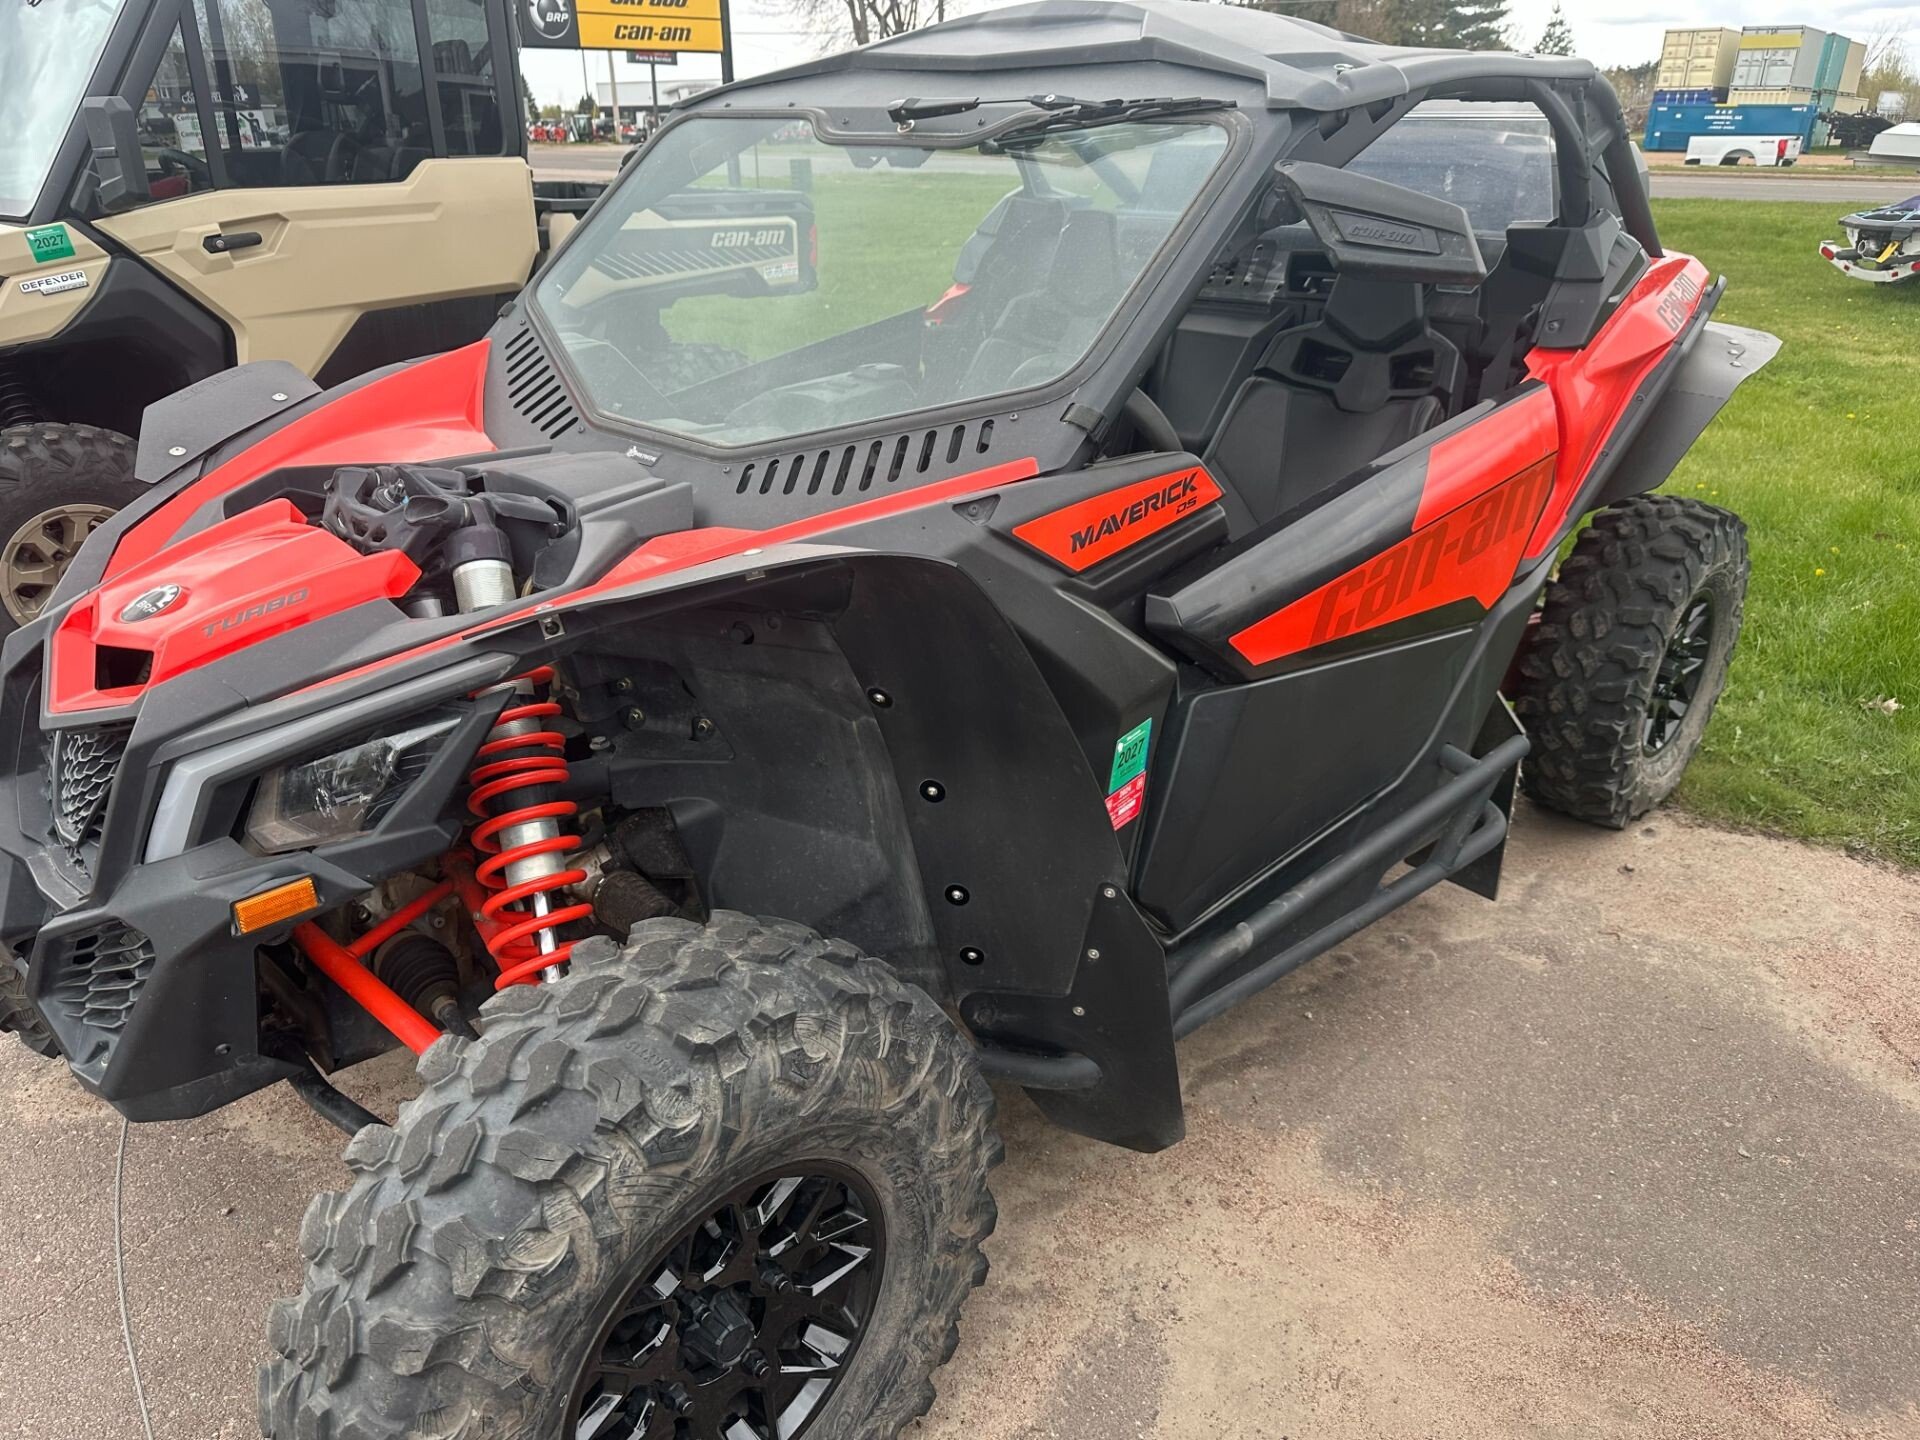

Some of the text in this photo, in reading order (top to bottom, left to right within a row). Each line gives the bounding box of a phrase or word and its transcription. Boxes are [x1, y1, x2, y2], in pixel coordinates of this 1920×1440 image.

[546, 12, 569, 23] BRP
[614, 24, 691, 42] can-am
[34, 234, 64, 249] 2027
[711, 230, 785, 247] can-am
[22, 272, 84, 290] DEFENDER
[1656, 272, 1700, 334] can-am
[1071, 472, 1197, 553] MAVERICK
[1176, 496, 1198, 515] DS
[1311, 464, 1549, 647] can-am
[136, 600, 157, 613] BRP
[202, 588, 309, 638] TURBO
[1117, 738, 1145, 769] 2027
